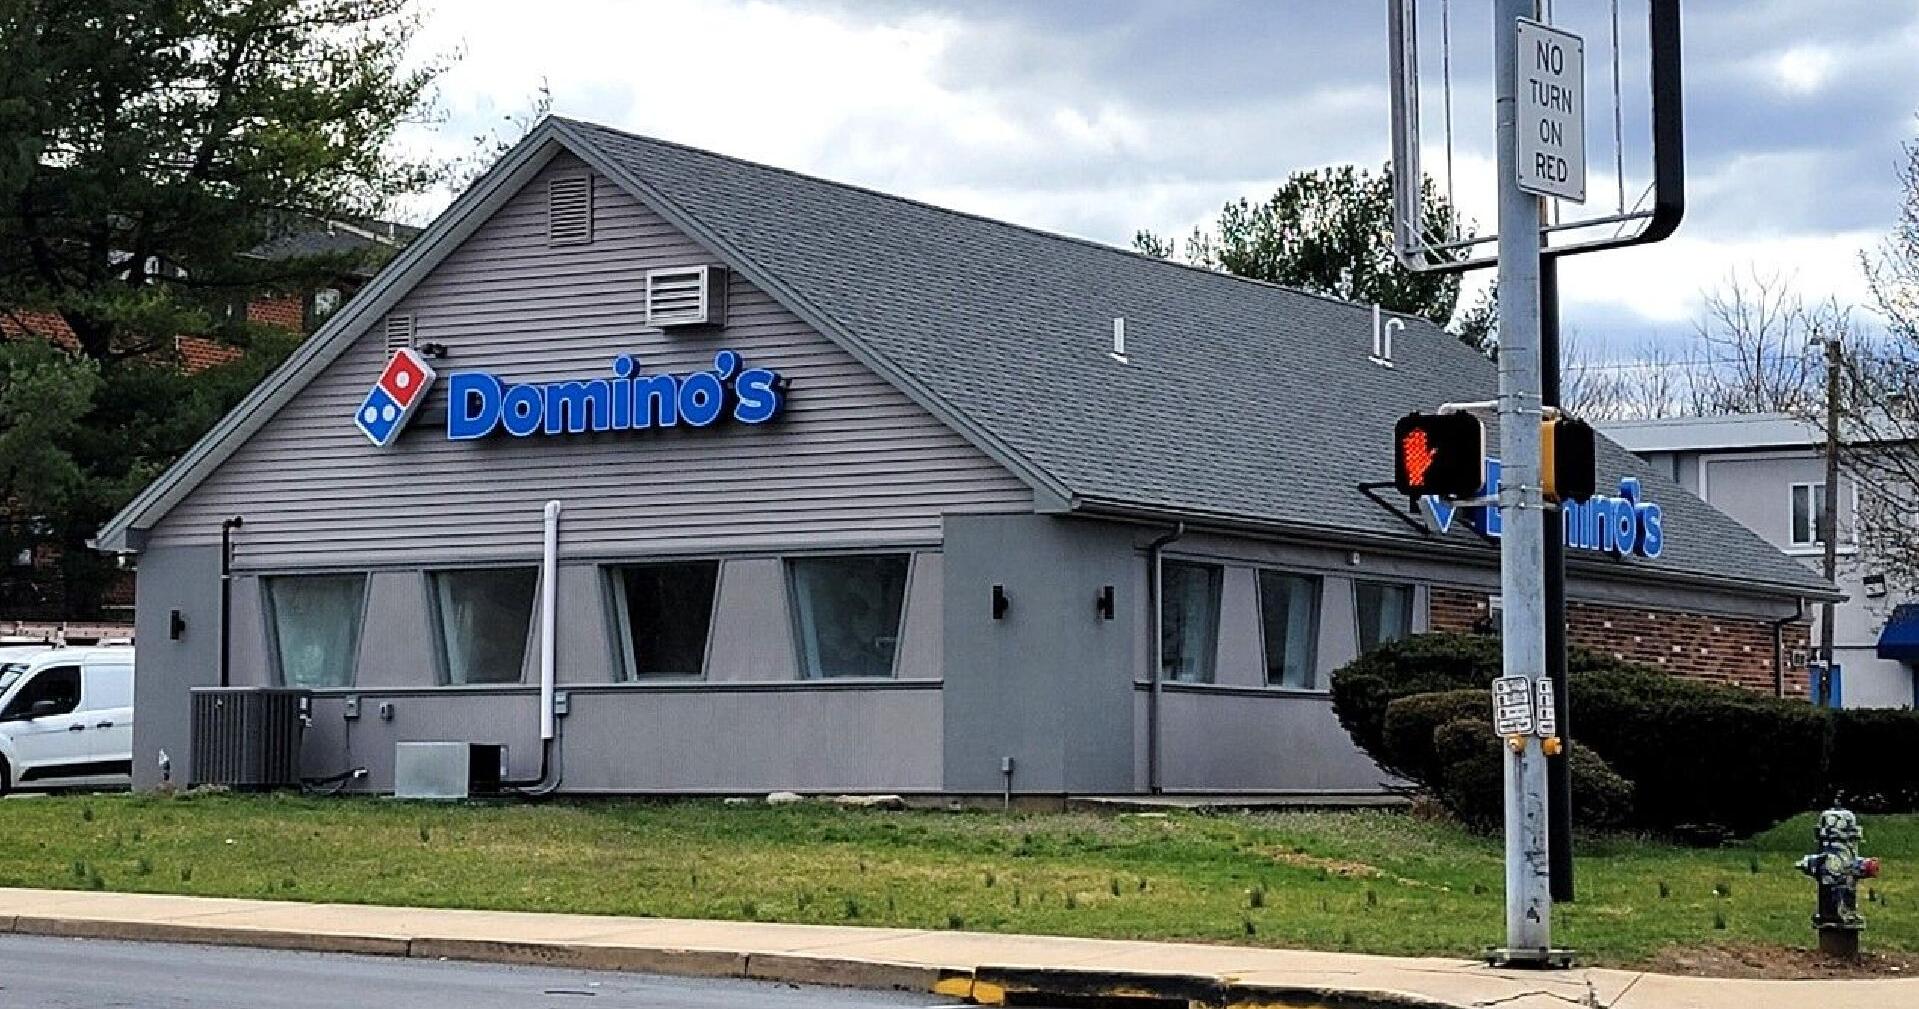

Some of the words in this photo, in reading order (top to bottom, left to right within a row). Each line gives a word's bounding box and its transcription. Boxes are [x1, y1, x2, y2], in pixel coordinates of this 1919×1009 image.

[1536, 39, 1564, 76] NO
[1529, 78, 1572, 115] TURN
[1539, 118, 1563, 147] ON
[1535, 152, 1569, 183] RED
[447, 350, 779, 440] Domino's
